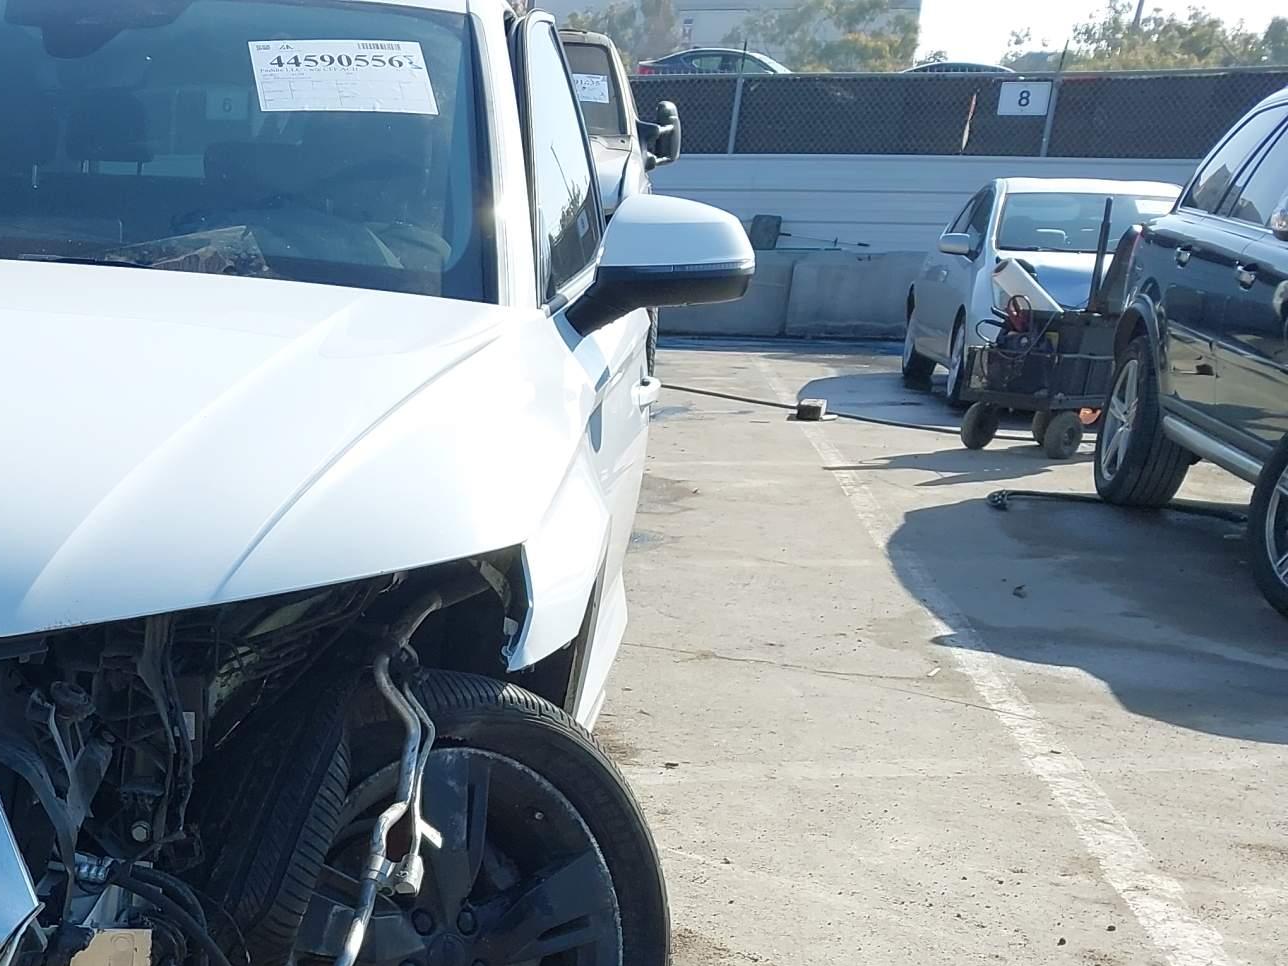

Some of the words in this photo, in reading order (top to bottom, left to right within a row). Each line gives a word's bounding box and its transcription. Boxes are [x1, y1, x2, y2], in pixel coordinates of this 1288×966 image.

[269, 54, 404, 68] 44590556
[222, 97, 232, 112] 6
[1018, 90, 1031, 107] 8
